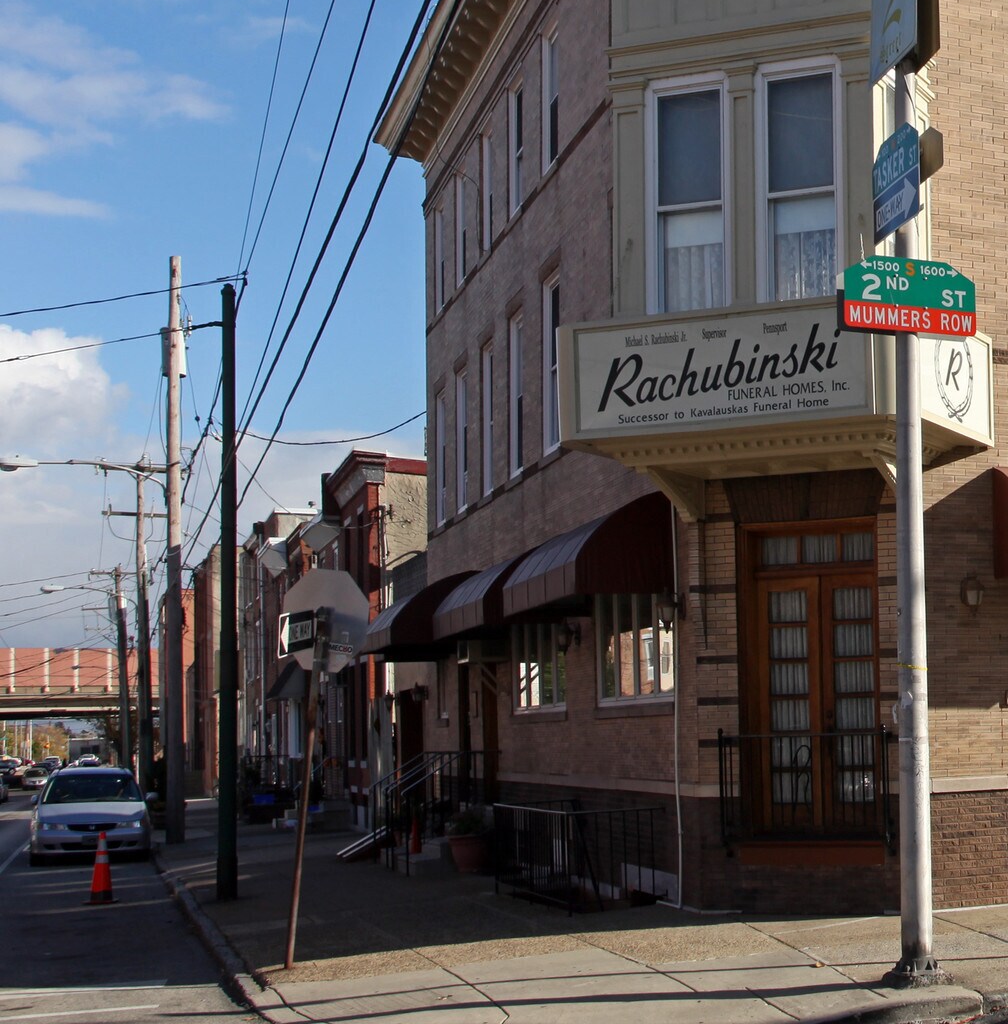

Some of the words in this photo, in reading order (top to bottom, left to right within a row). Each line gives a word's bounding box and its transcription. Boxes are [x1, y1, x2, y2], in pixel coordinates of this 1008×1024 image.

[873, 147, 905, 194] TASKER
[908, 144, 918, 166] ST
[872, 260, 900, 272] 1500
[904, 262, 916, 276] S
[920, 265, 946, 277] 1600
[861, 273, 910, 301] 2ND
[941, 289, 967, 308] ST
[763, 321, 788, 335] Pennsport
[849, 304, 931, 330] MUMMERS
[940, 312, 972, 333] ROW
[625, 333, 643, 347] Michael
[644, 334, 650, 346] S.
[651, 331, 679, 346] Rachubinski
[680, 330, 688, 343] Jr.
[701, 327, 728, 342] Supervisor
[597, 322, 841, 413] Rachubinski
[945, 348, 963, 391] R
[727, 384, 778, 401] FUNERAL
[831, 380, 850, 392] Inc.
[618, 412, 669, 425] Successor
[674, 410, 685, 420] to
[690, 404, 749, 418] Kavalauskas
[753, 399, 793, 413] Funeral
[796, 397, 830, 409] Home
